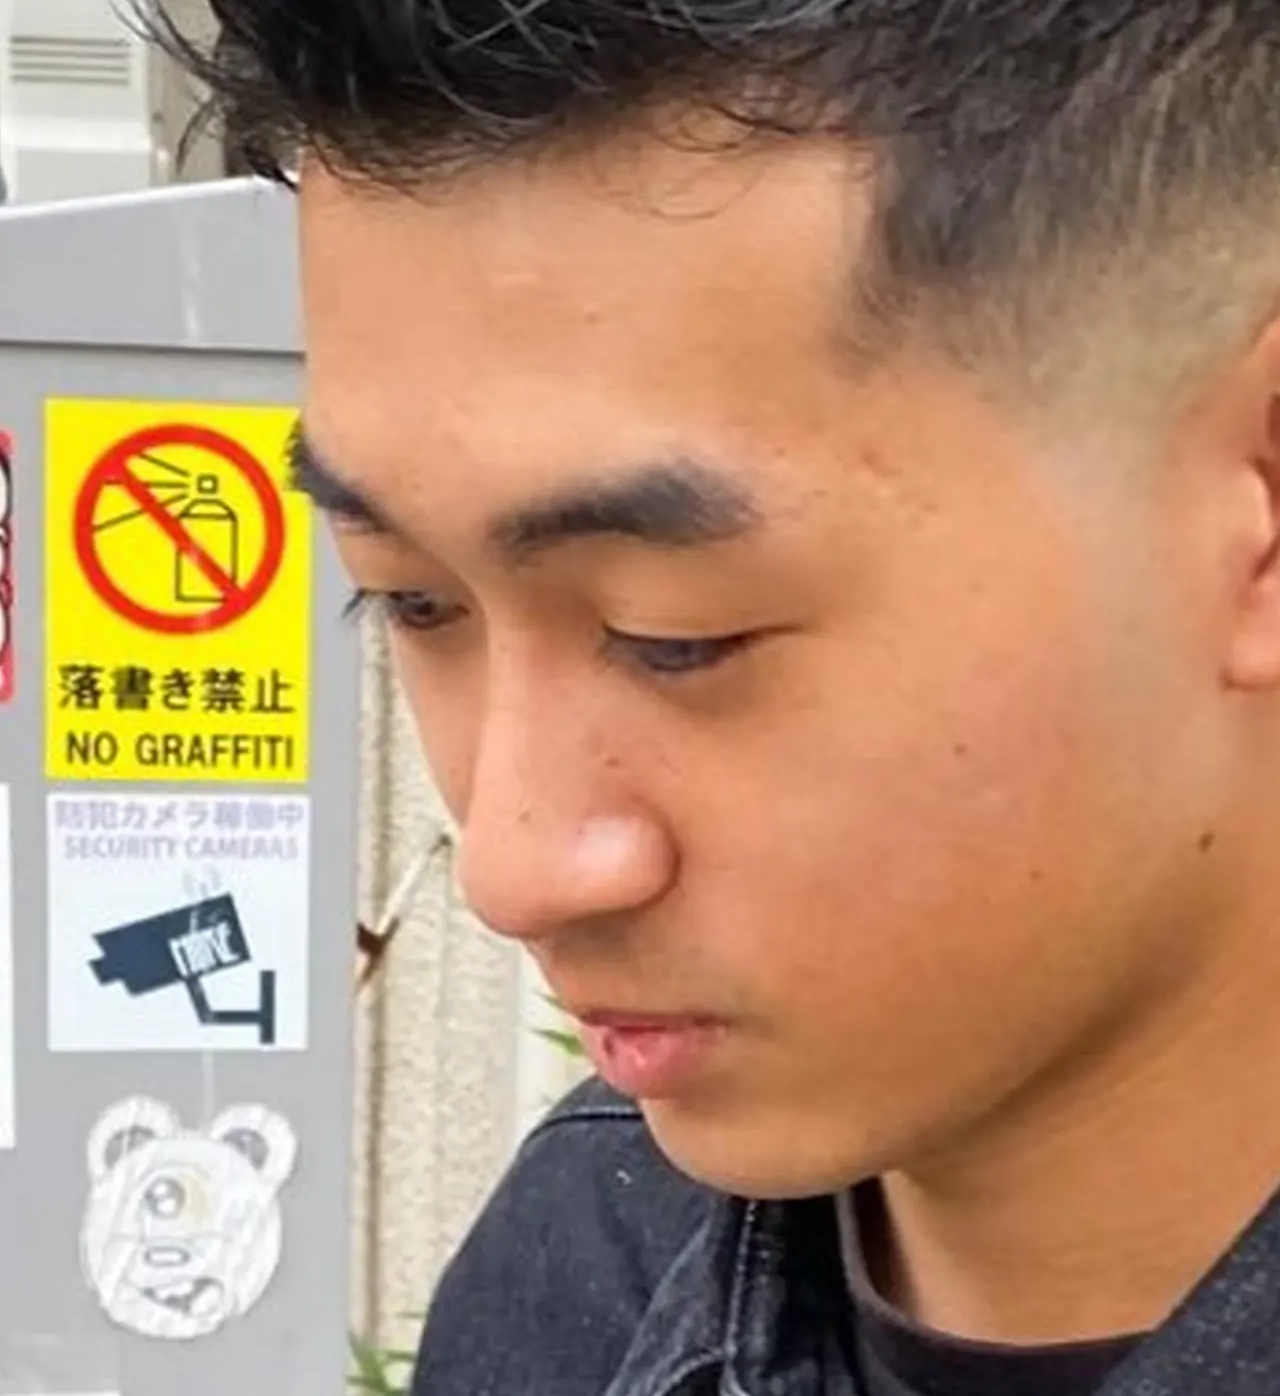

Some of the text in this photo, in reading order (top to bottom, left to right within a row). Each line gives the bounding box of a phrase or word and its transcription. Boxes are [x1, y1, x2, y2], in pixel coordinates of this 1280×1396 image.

[58, 665, 296, 713] 落書き禁止
[66, 731, 294, 769] NO GRAFFITI
